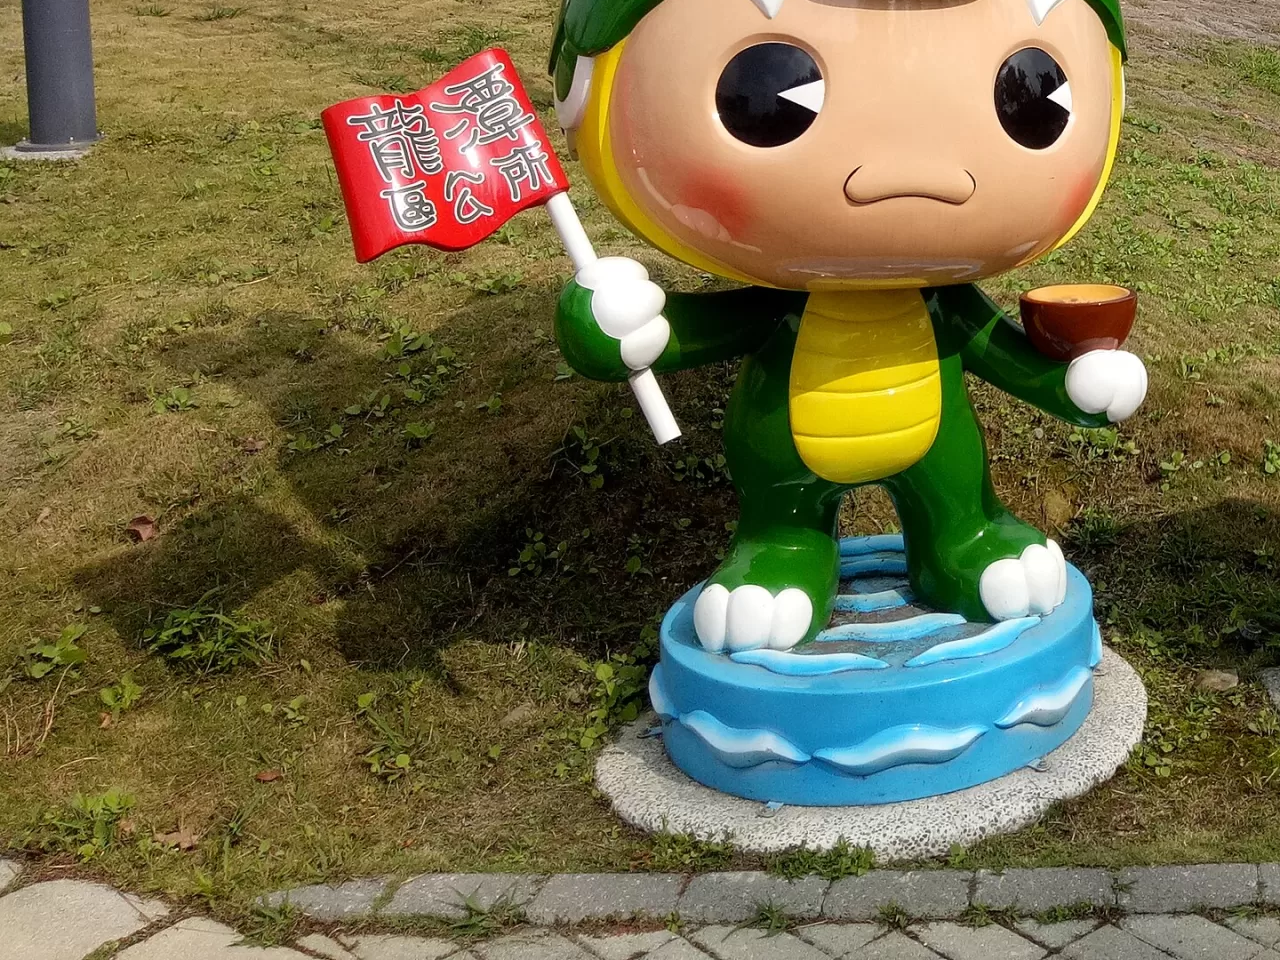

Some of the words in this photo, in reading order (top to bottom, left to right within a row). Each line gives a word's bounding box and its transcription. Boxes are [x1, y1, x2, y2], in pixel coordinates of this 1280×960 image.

[347, 63, 535, 182] 龍潭
[380, 140, 552, 232] 區公所
